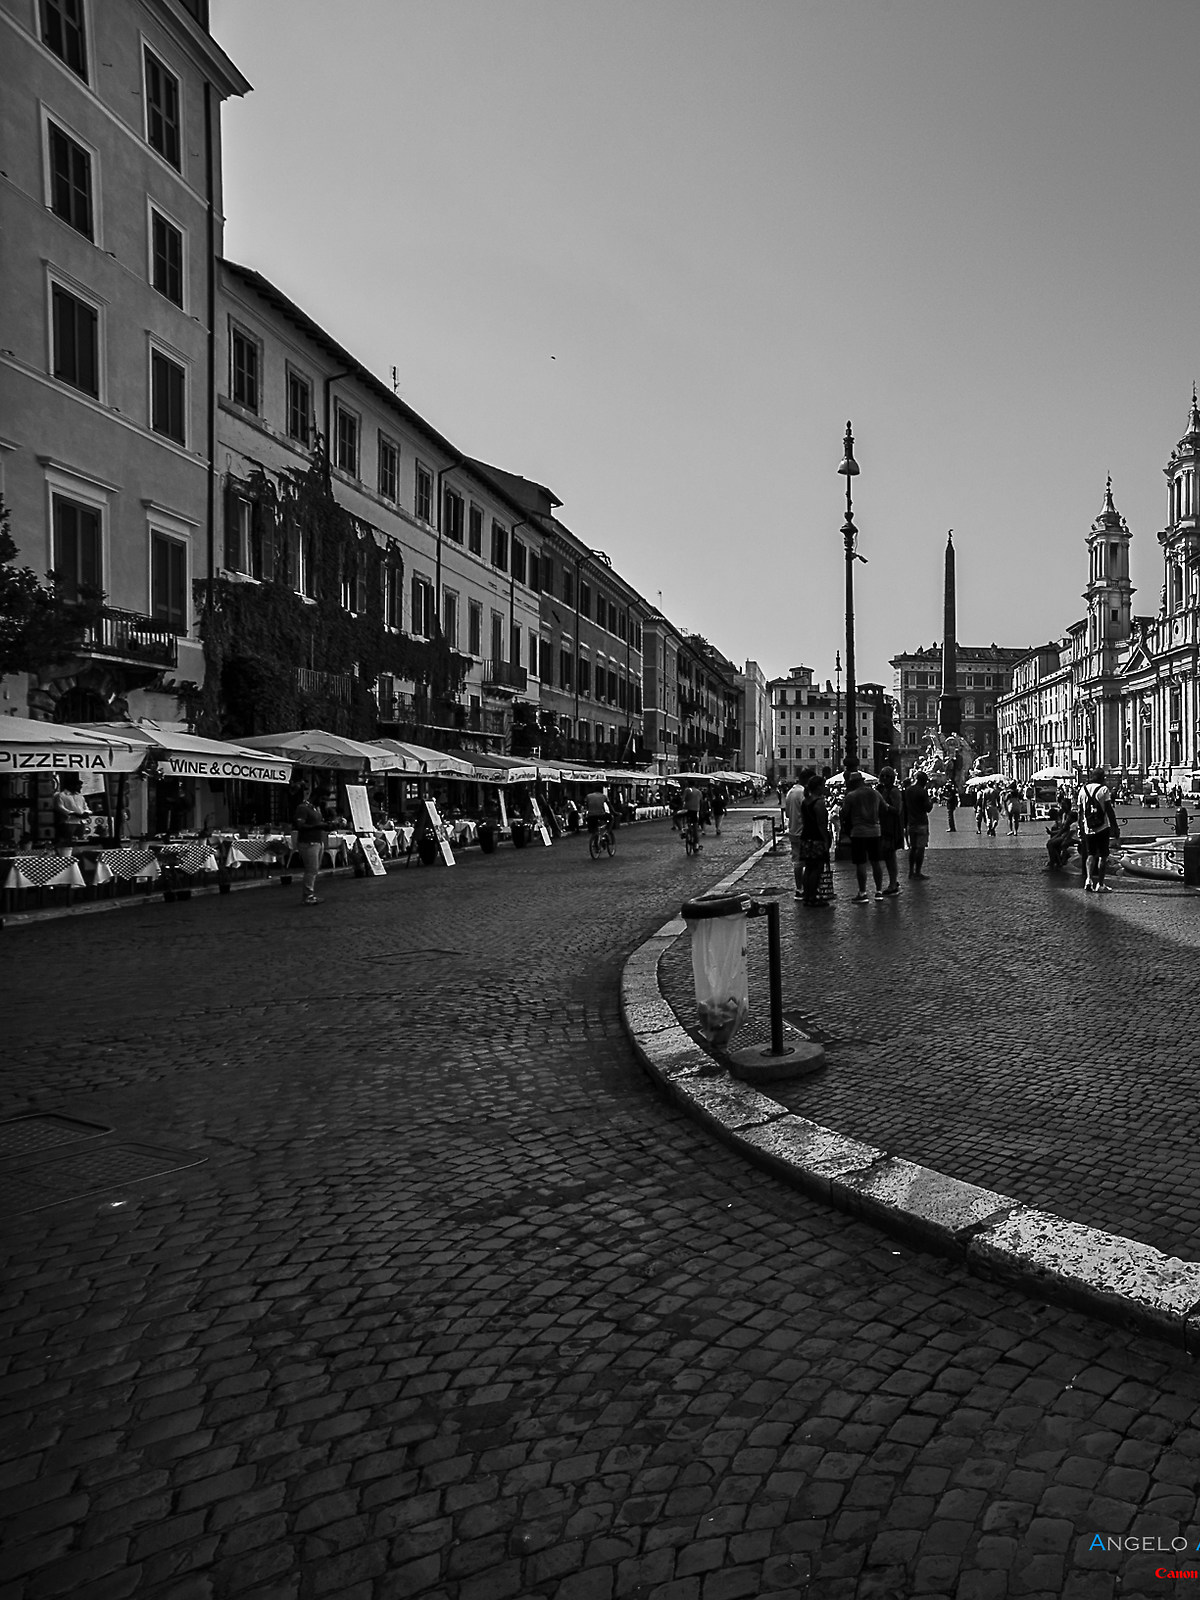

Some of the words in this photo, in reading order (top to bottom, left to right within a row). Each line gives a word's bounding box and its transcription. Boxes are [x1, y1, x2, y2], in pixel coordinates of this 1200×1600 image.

[0, 751, 106, 769] PIZZERIA
[170, 759, 208, 775] WINE
[210, 762, 220, 776] &
[222, 762, 287, 781] COCKTAILS
